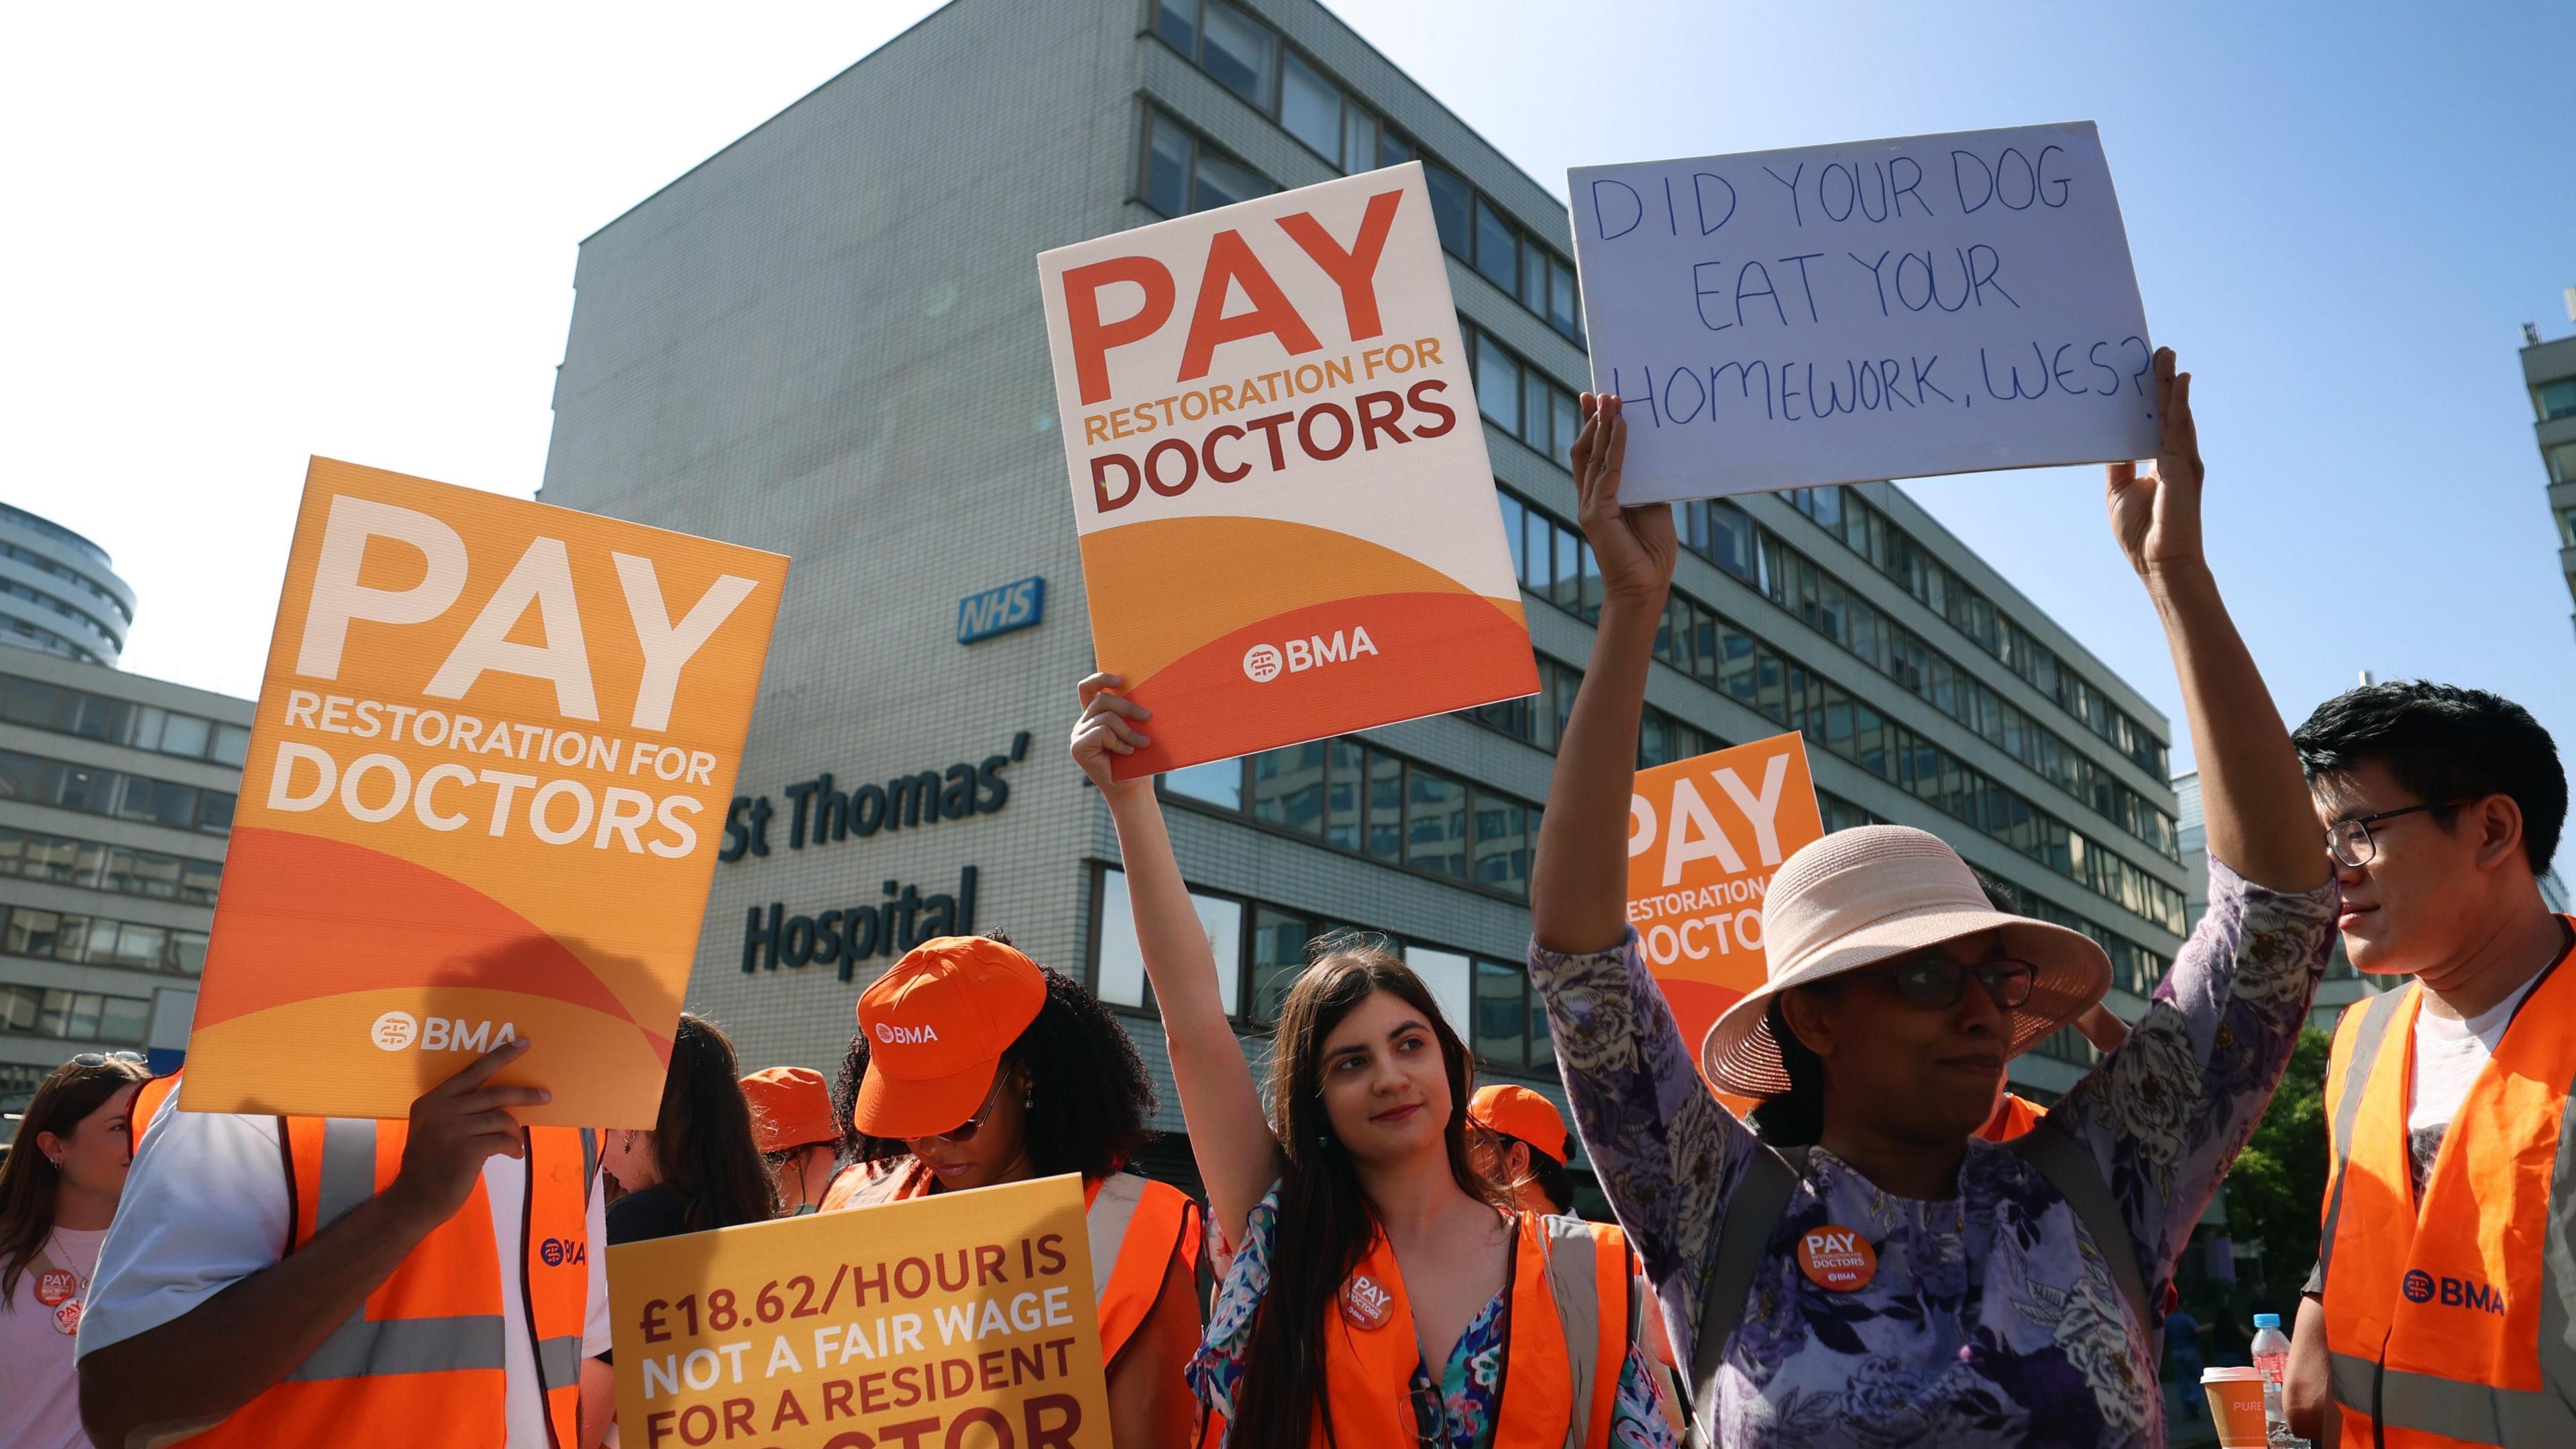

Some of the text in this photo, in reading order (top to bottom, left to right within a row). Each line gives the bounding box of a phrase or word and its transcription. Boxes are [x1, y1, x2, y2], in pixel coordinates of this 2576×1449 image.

[1592, 145, 2072, 240] DID YOUR DOG
[1061, 188, 1405, 407] PAY
[1693, 244, 2021, 331] EAT YOUR
[1083, 337, 1444, 446] RESTORATION FOR
[1613, 335, 2153, 429] HOMEWORK, WES?
[1090, 379, 1457, 514] DOCTORS
[294, 494, 759, 733] PAY
[959, 581, 1034, 637] NHS
[1285, 625, 1379, 672] BMA
[285, 690, 717, 788] RESTORATION FOR
[267, 742, 704, 859] DOCTORS
[718, 731, 1031, 863] St Thomas'
[742, 865, 977, 983] Hospital
[1626, 876, 1766, 922] ESTORATION
[1638, 908, 1765, 965] OCTO
[421, 1017, 515, 1053] BMA
[893, 1024, 938, 1044] BMA
[1807, 1233, 1856, 1254] PAY
[1813, 1257, 1865, 1269] DOCTORS
[1837, 1272, 1857, 1281] BMA
[43, 1275, 71, 1286] PAY
[56, 1300, 80, 1322] PAY
[639, 1233, 1067, 1344] £18.62/HOUR IS
[1347, 1293, 1380, 1320] DOCTORS
[1354, 1276, 1391, 1307] PAY
[2440, 1277, 2505, 1317] BMA
[642, 1285, 1073, 1399] NOT A FAIR WAGE
[647, 1338, 1075, 1449] FOR A RESIDENT
